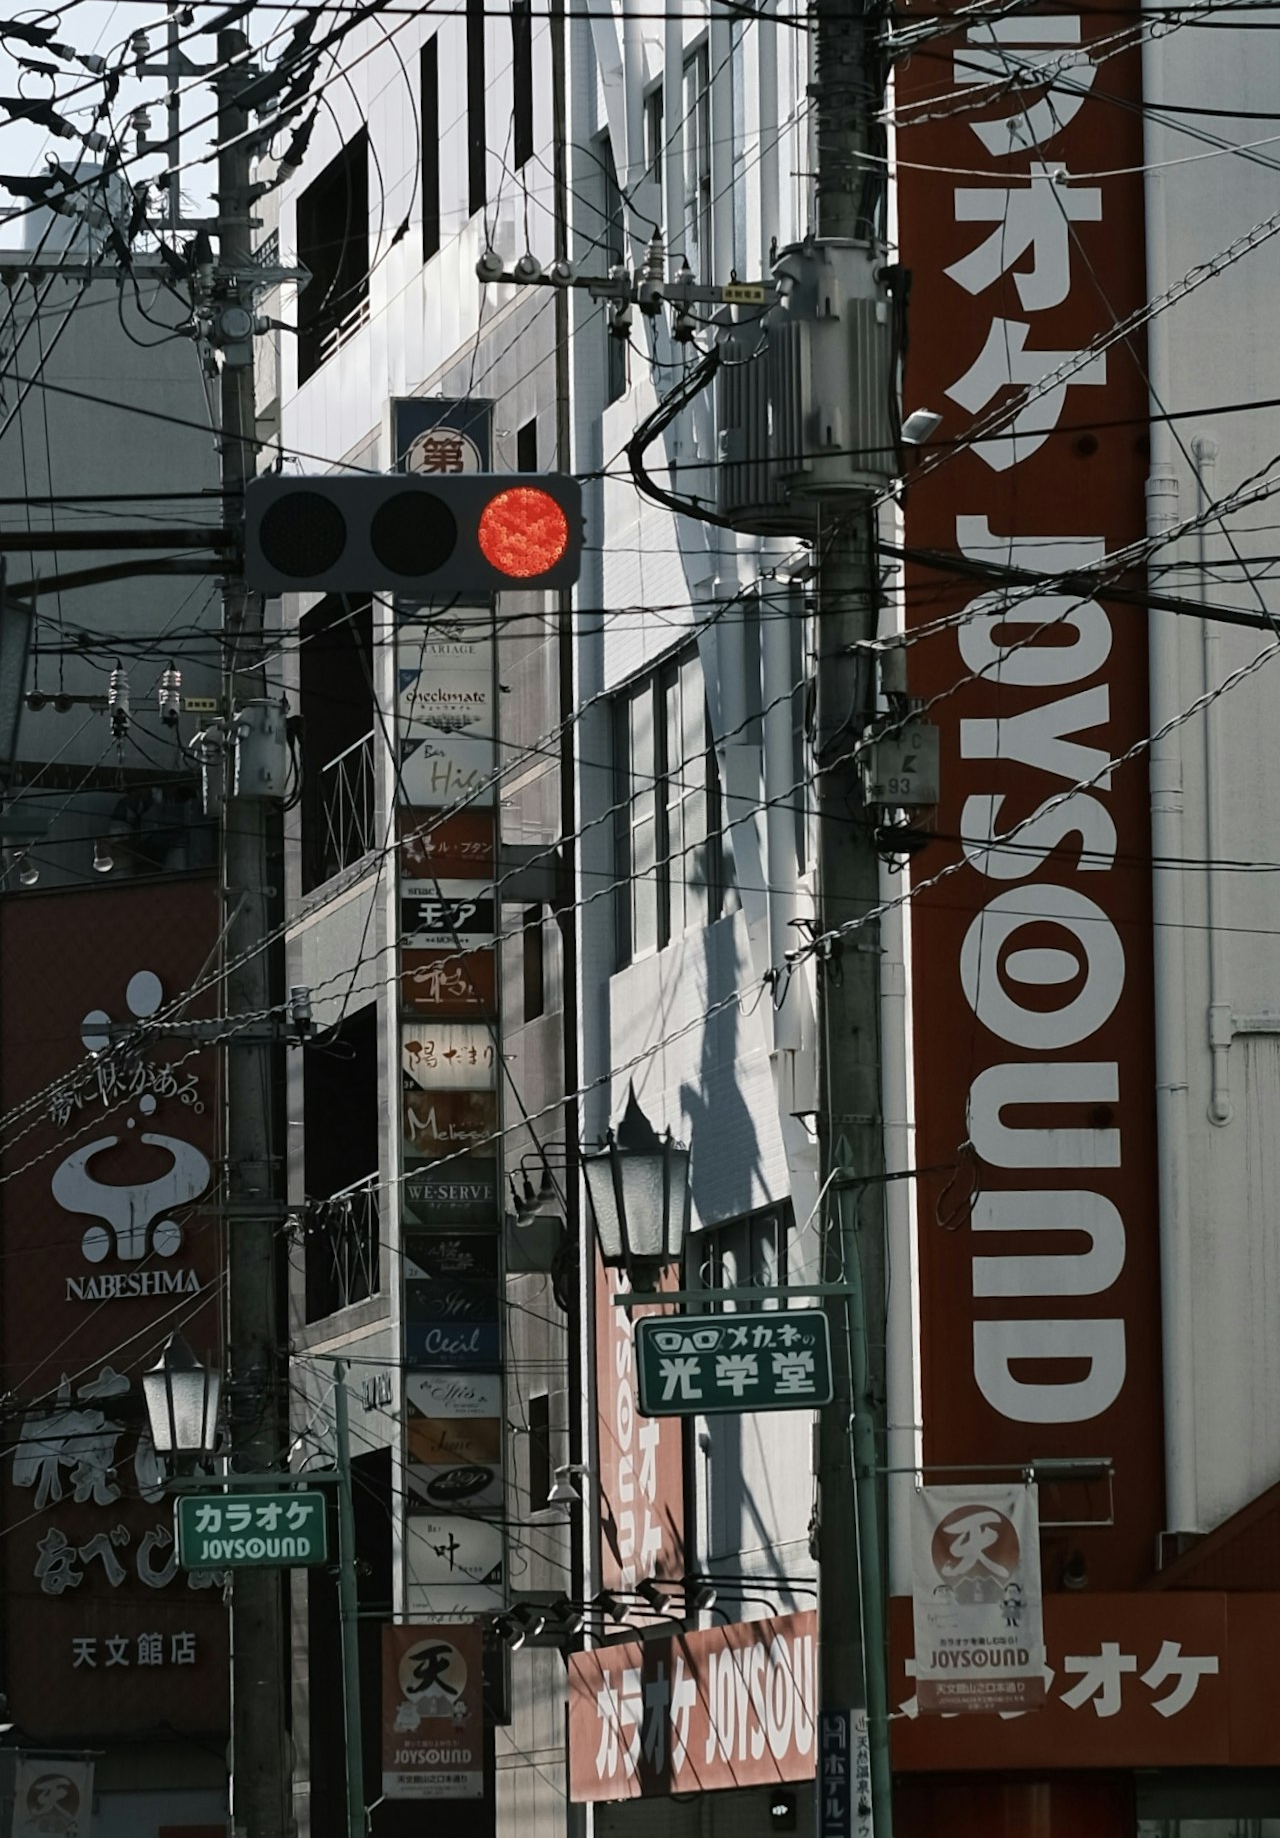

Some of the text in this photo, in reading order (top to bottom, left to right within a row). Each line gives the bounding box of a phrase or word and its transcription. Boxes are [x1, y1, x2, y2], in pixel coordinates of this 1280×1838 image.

[888, 777, 910, 794] 93
[417, 902, 477, 928] モア
[956, 514, 1126, 1423] JOYSOUND
[405, 1041, 494, 1071] 陽だまり
[64, 1267, 202, 1302] NABESHIMA
[425, 1328, 480, 1354] Cecil
[658, 1350, 817, 1401] 光学堂
[194, 1502, 314, 1535] カラオケ
[200, 1535, 311, 1560] JOYSOUND
[71, 1631, 197, 1668] 天文館店
[930, 1648, 1030, 1669] JOYSOUND
[705, 1633, 818, 1766] JOYSOU
[595, 1656, 697, 1781] カラオケ
[393, 1749, 472, 1765] JOYSOUND
